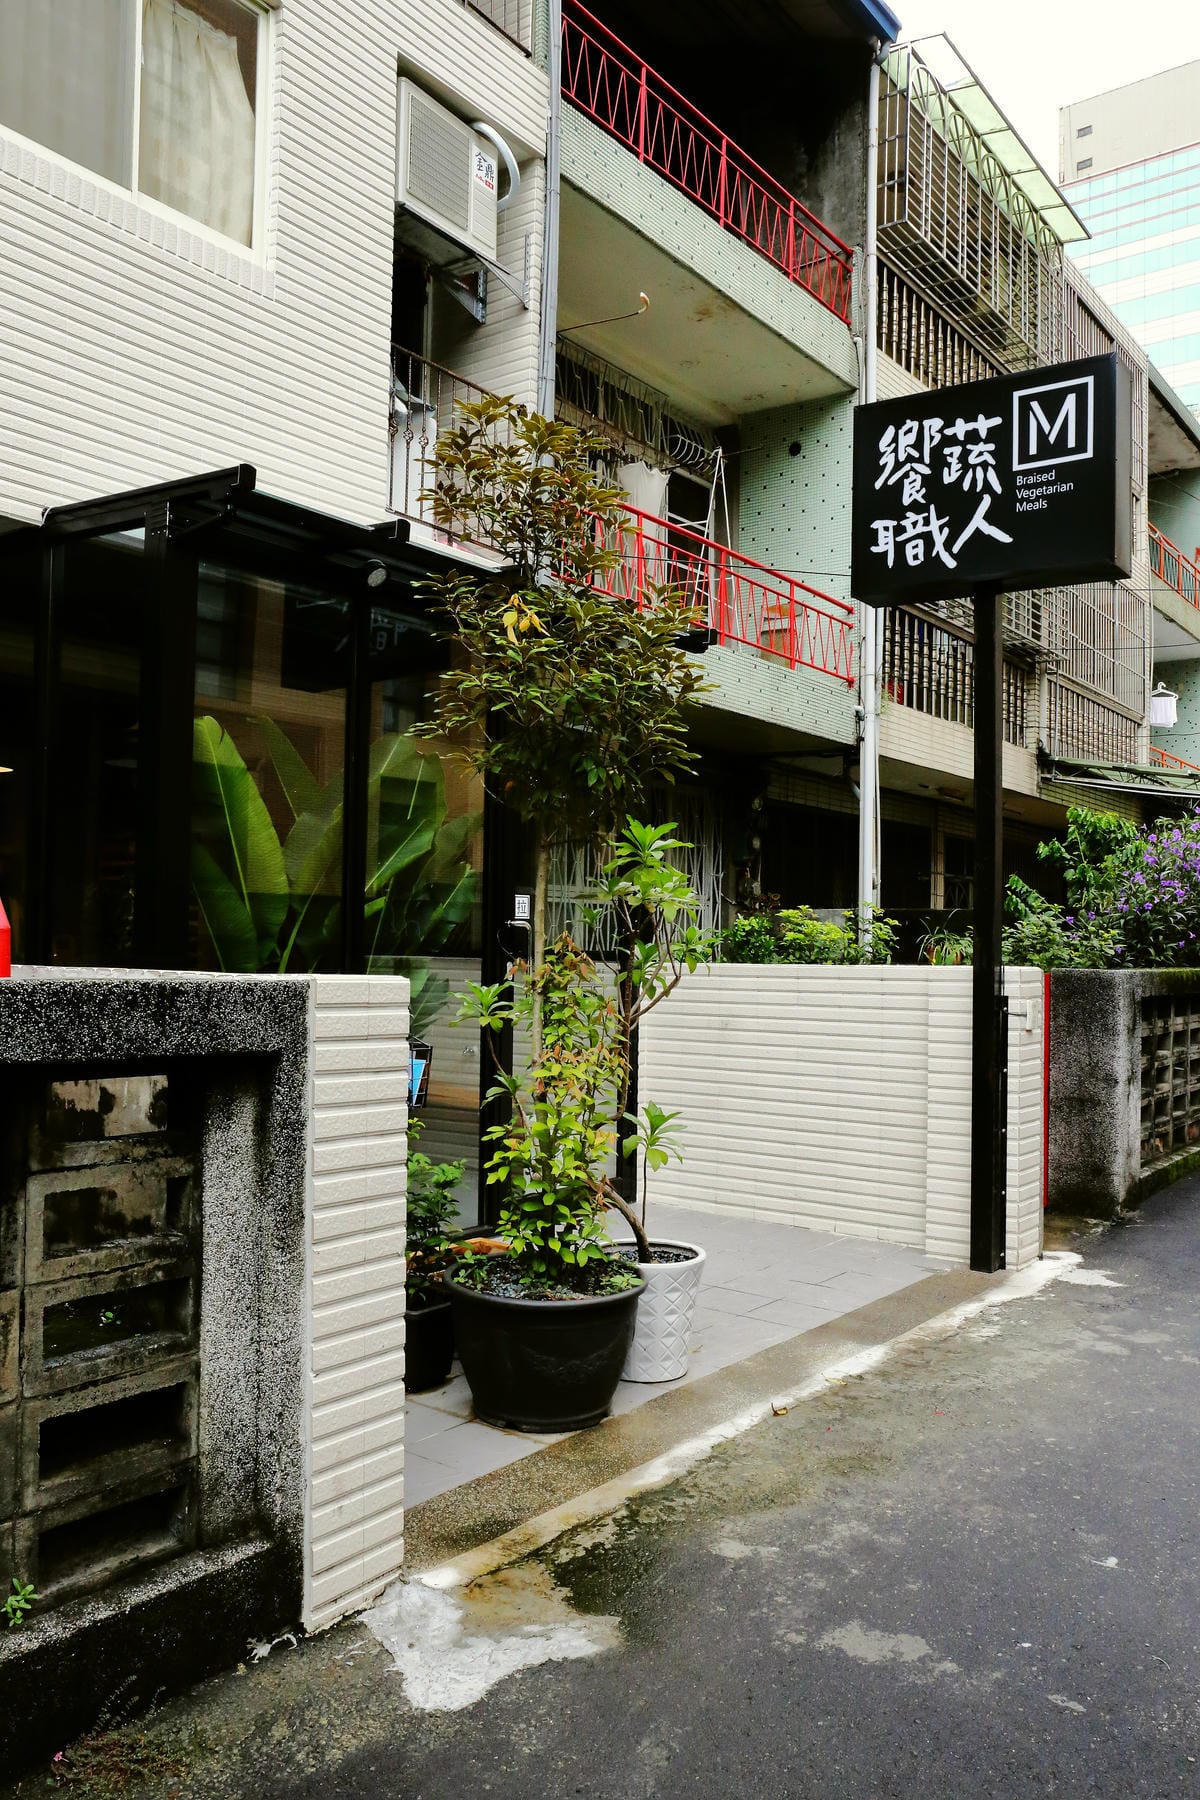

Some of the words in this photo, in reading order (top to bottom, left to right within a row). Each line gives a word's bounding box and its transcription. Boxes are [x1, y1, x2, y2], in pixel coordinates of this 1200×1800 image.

[1029, 393, 1076, 456] M
[875, 414, 1002, 506] 饗蔬
[1016, 470, 1056, 486] Braised
[1016, 481, 1074, 500] Vegetarian
[1016, 499, 1048, 513] Meals
[871, 494, 1013, 569] 職人
